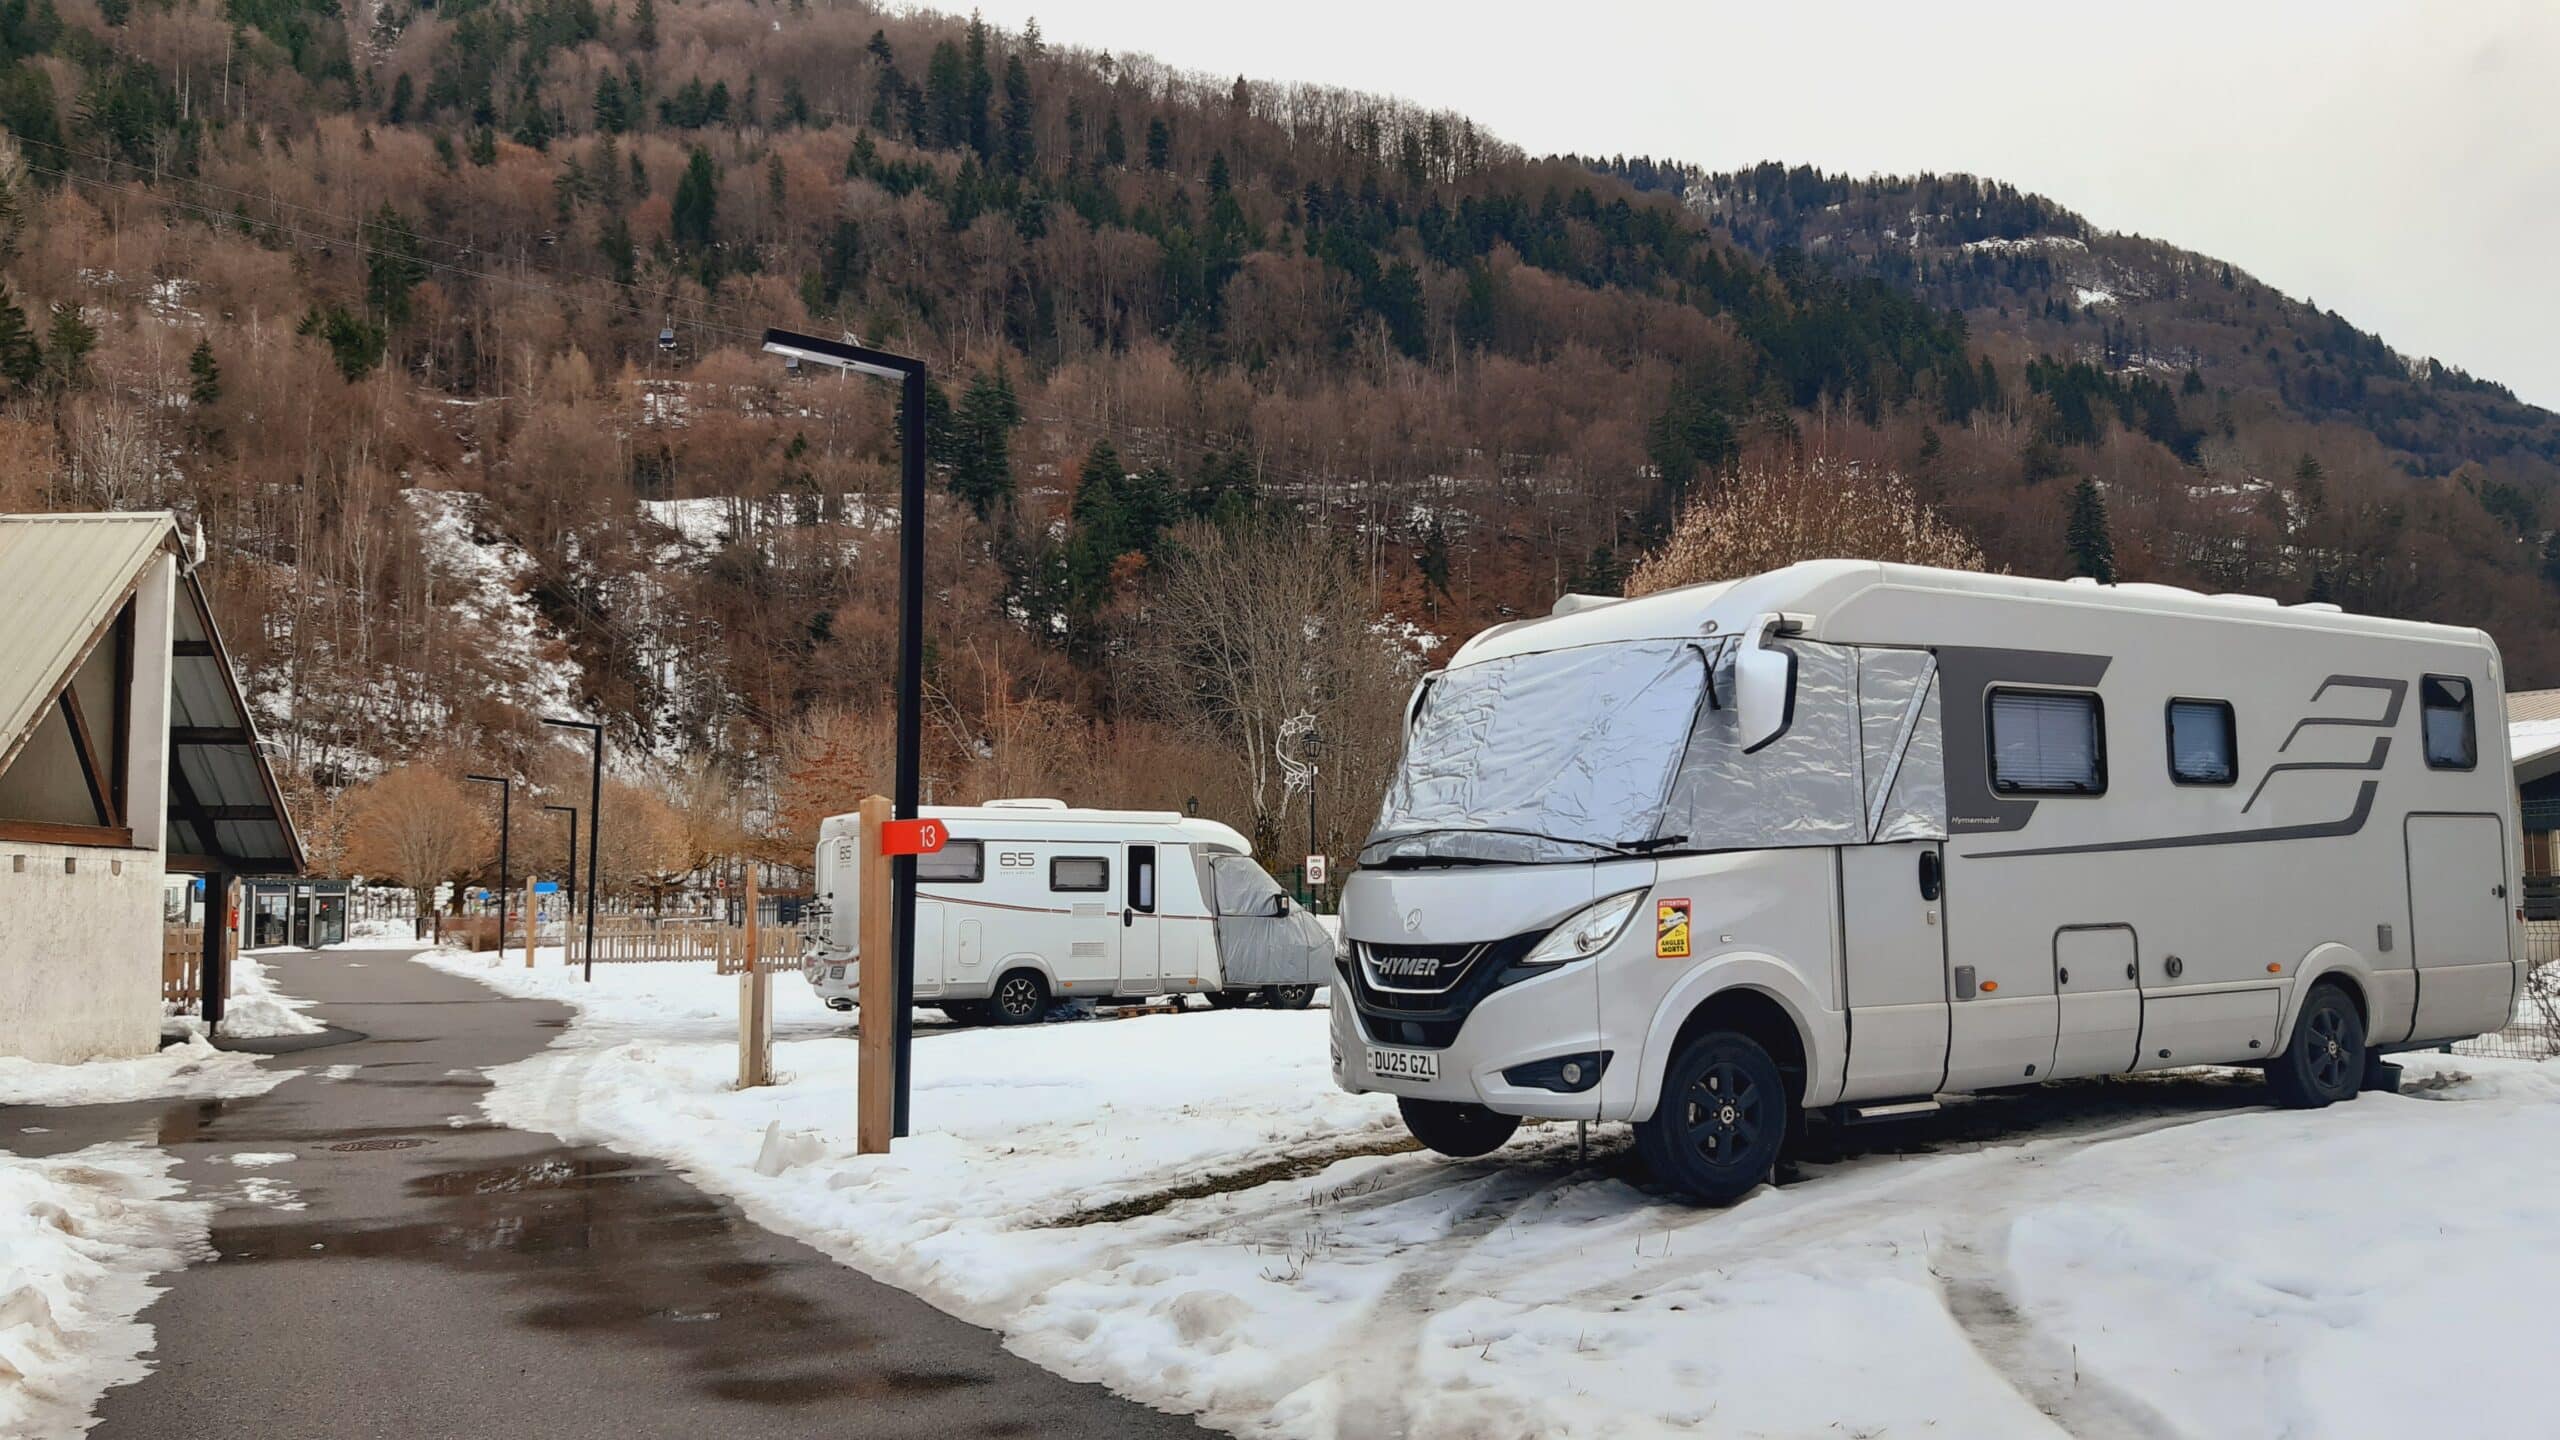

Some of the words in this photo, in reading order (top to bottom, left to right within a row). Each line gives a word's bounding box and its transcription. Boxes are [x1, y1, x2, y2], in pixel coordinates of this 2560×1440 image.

[1952, 816, 2000, 824] Hymermobil
[919, 824, 936, 848] 13
[839, 844, 852, 861] 65
[1000, 853, 1035, 867] 65
[1379, 957, 1440, 976] HYMER
[1375, 1051, 1407, 1072] DU25
[1410, 1054, 1436, 1075] GZL
